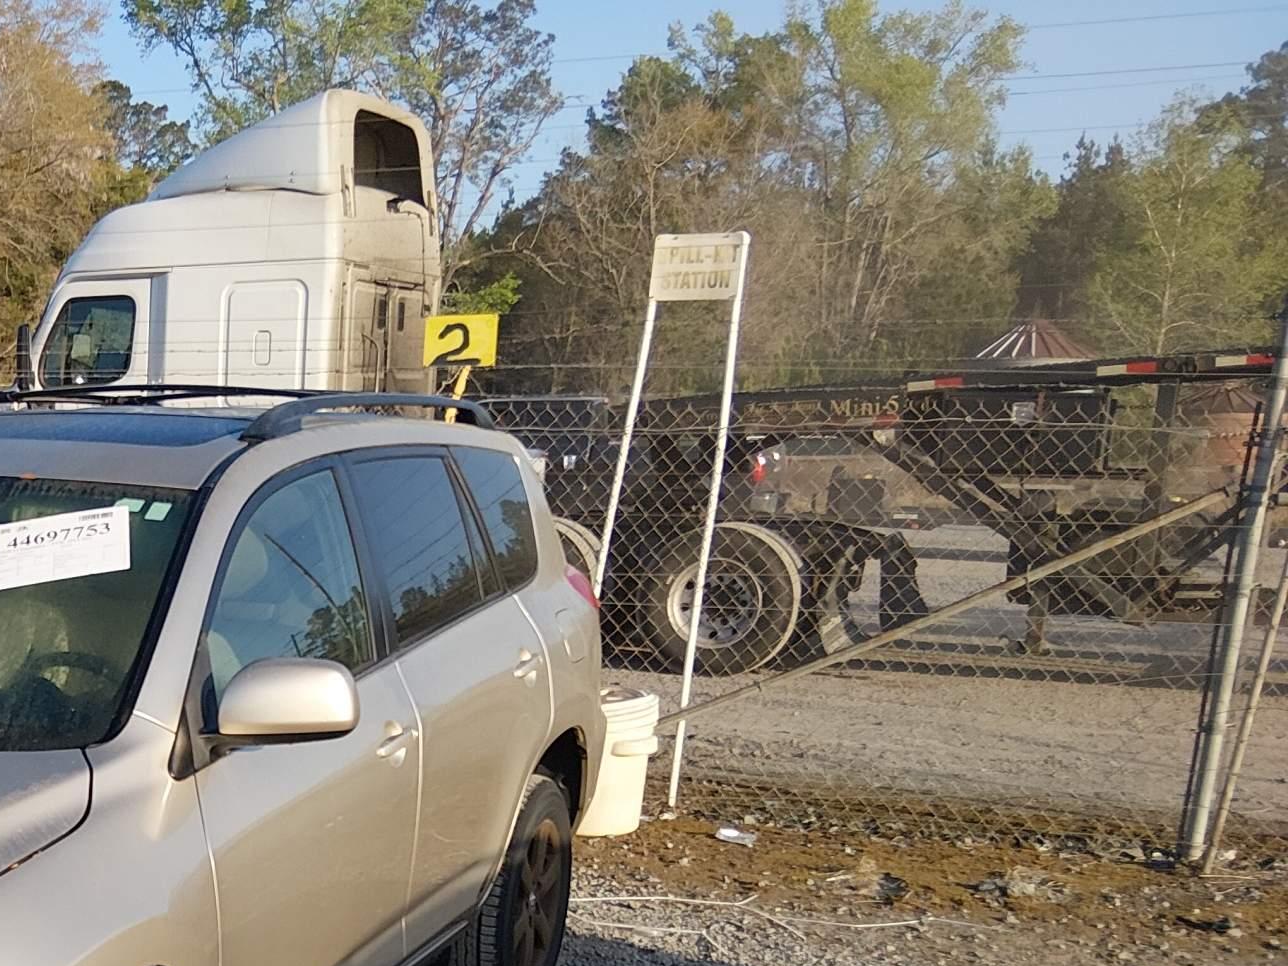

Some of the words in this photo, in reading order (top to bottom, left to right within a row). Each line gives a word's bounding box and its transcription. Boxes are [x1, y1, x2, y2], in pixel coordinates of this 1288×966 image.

[662, 271, 730, 289] STATION
[428, 323, 481, 366] 2
[7, 522, 111, 549] 44697753
